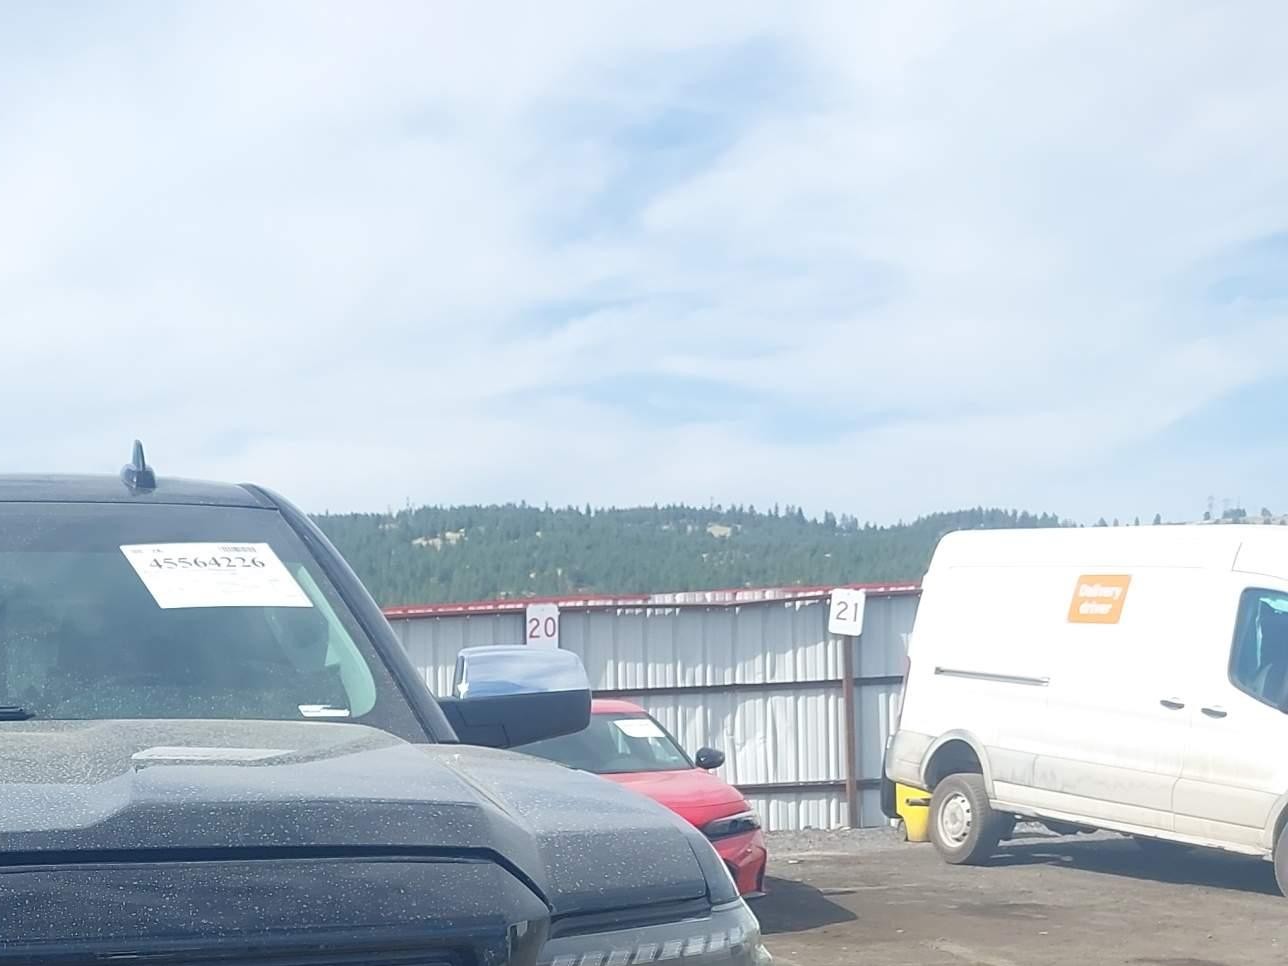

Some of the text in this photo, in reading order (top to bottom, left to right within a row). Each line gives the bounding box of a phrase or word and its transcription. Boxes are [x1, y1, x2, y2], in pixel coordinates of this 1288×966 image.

[149, 556, 266, 569] 45564226
[836, 600, 858, 622] 21
[529, 616, 556, 638] 20
